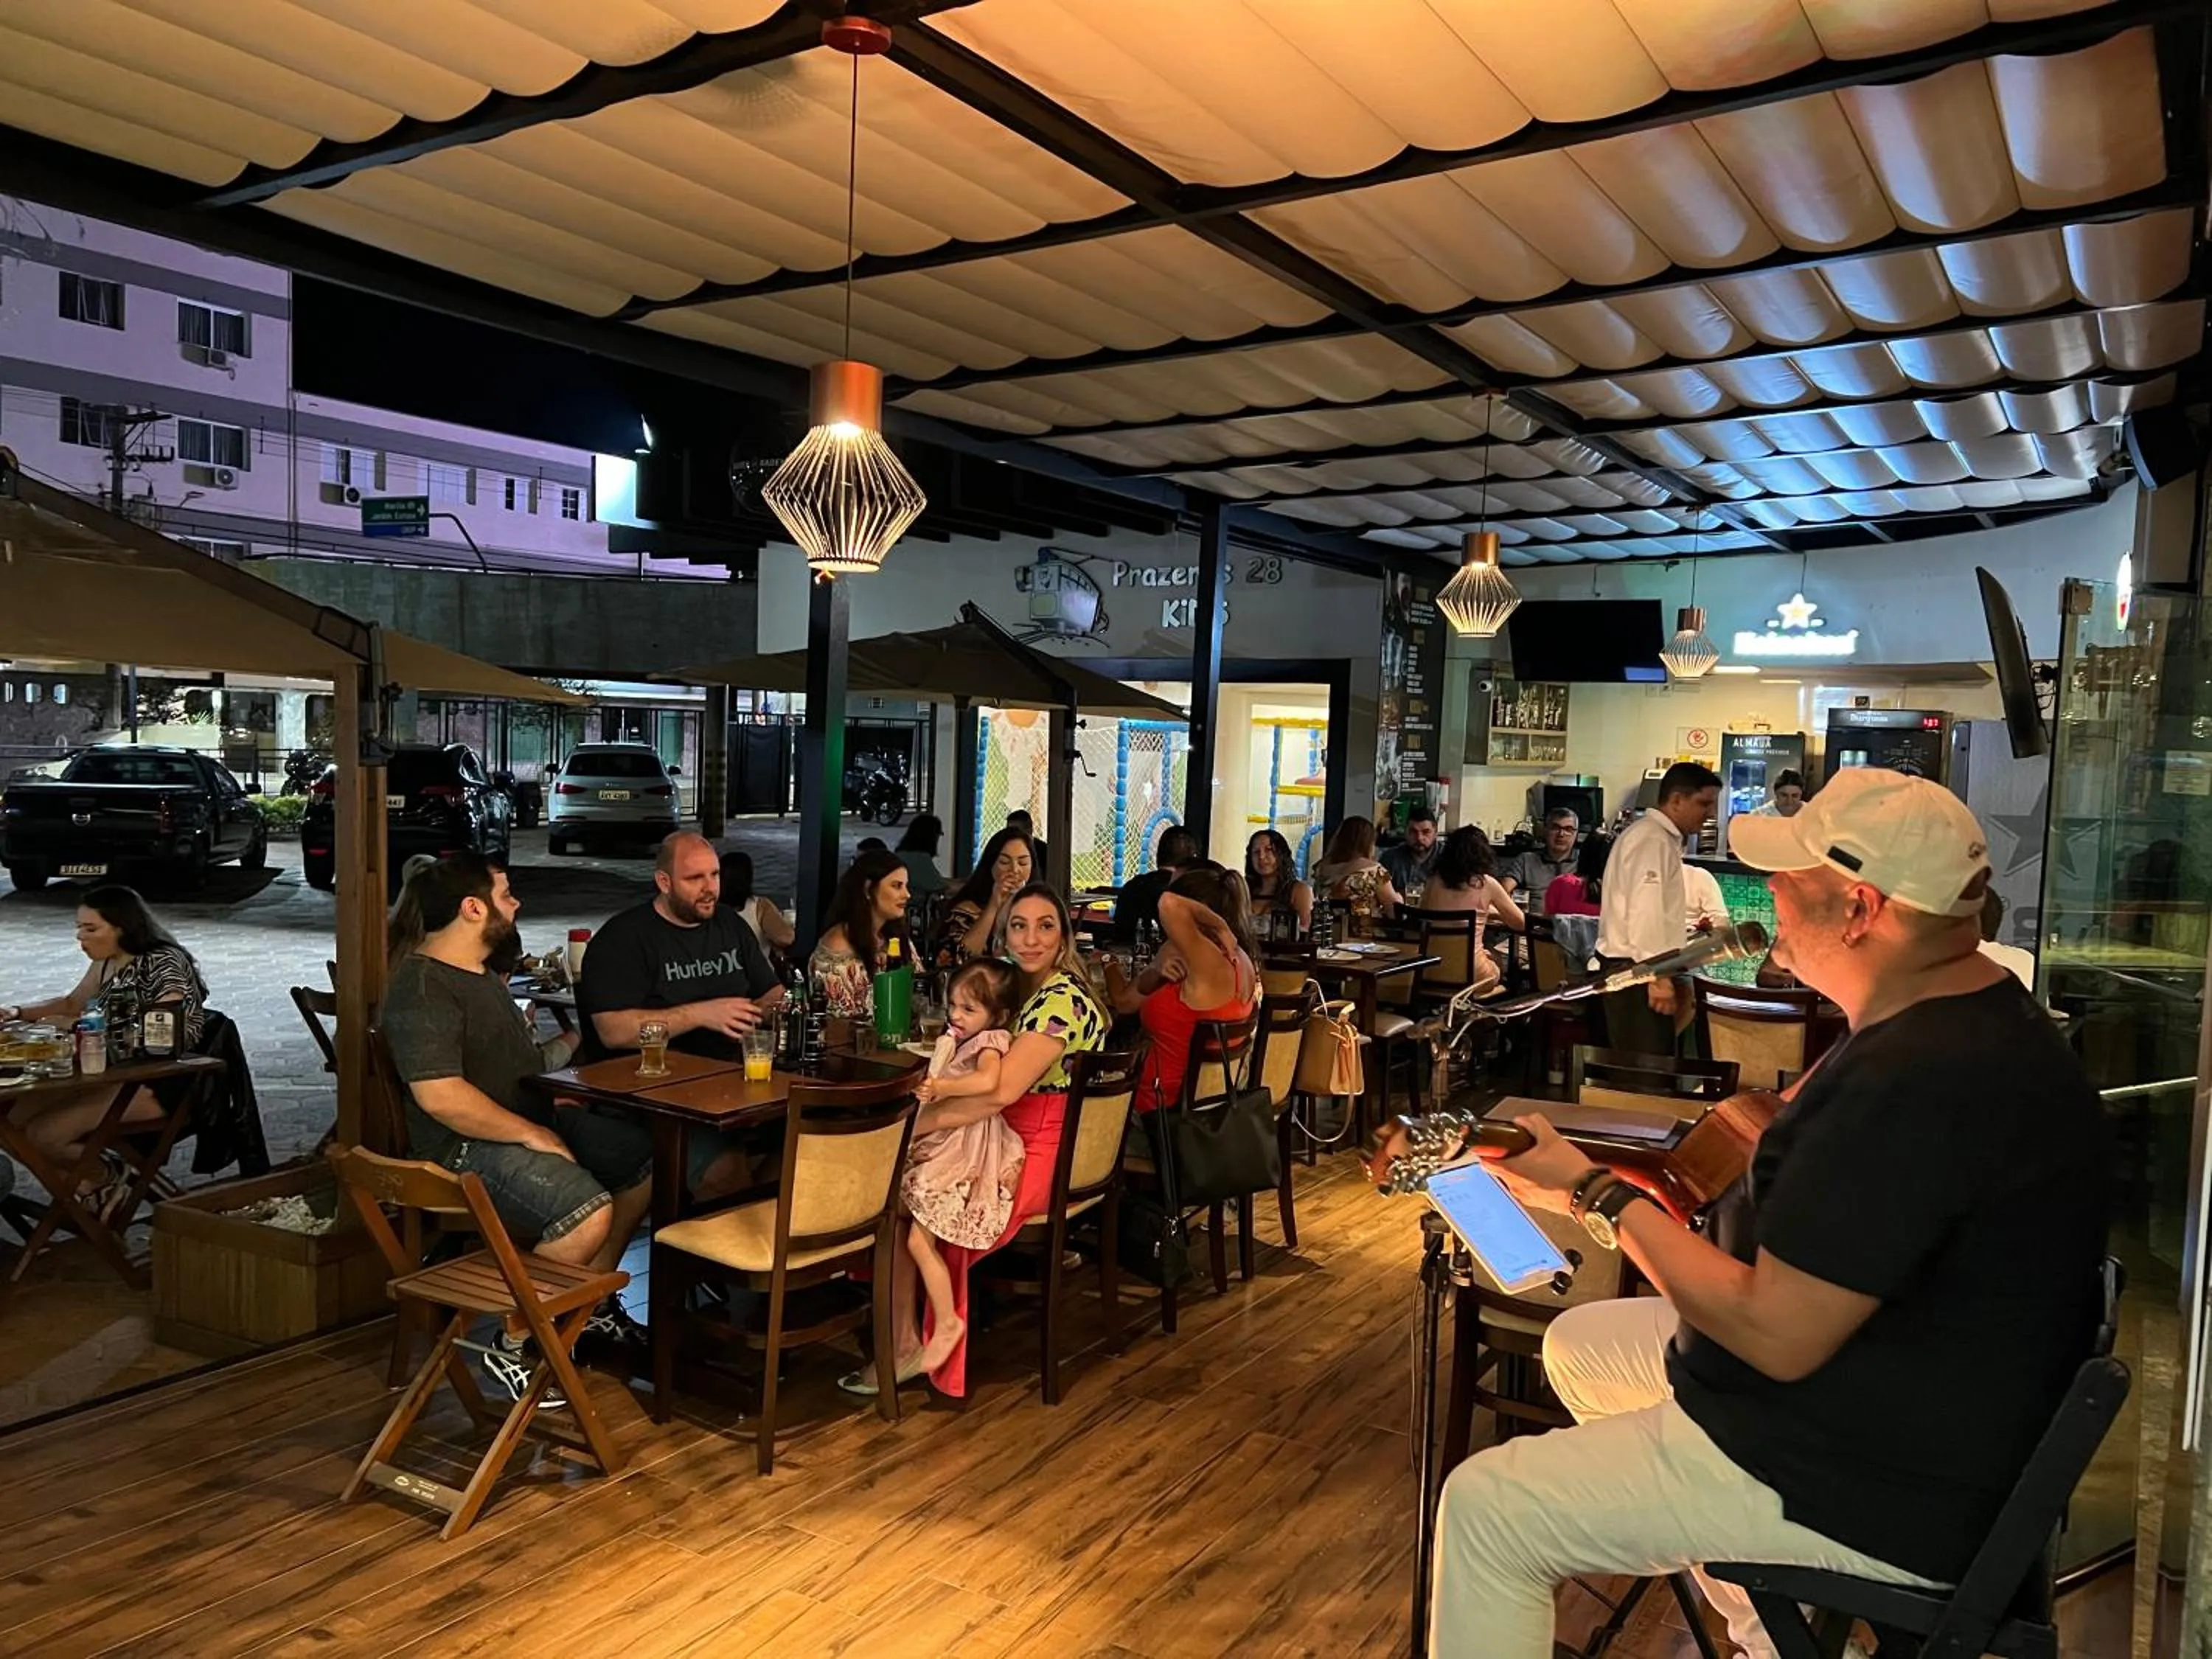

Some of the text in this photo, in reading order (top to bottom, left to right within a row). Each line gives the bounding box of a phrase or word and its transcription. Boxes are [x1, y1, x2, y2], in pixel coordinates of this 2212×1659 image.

[1112, 556, 1284, 588] Prazer 28
[1161, 598, 1231, 628] Ki
[664, 957, 723, 981] Hurley
